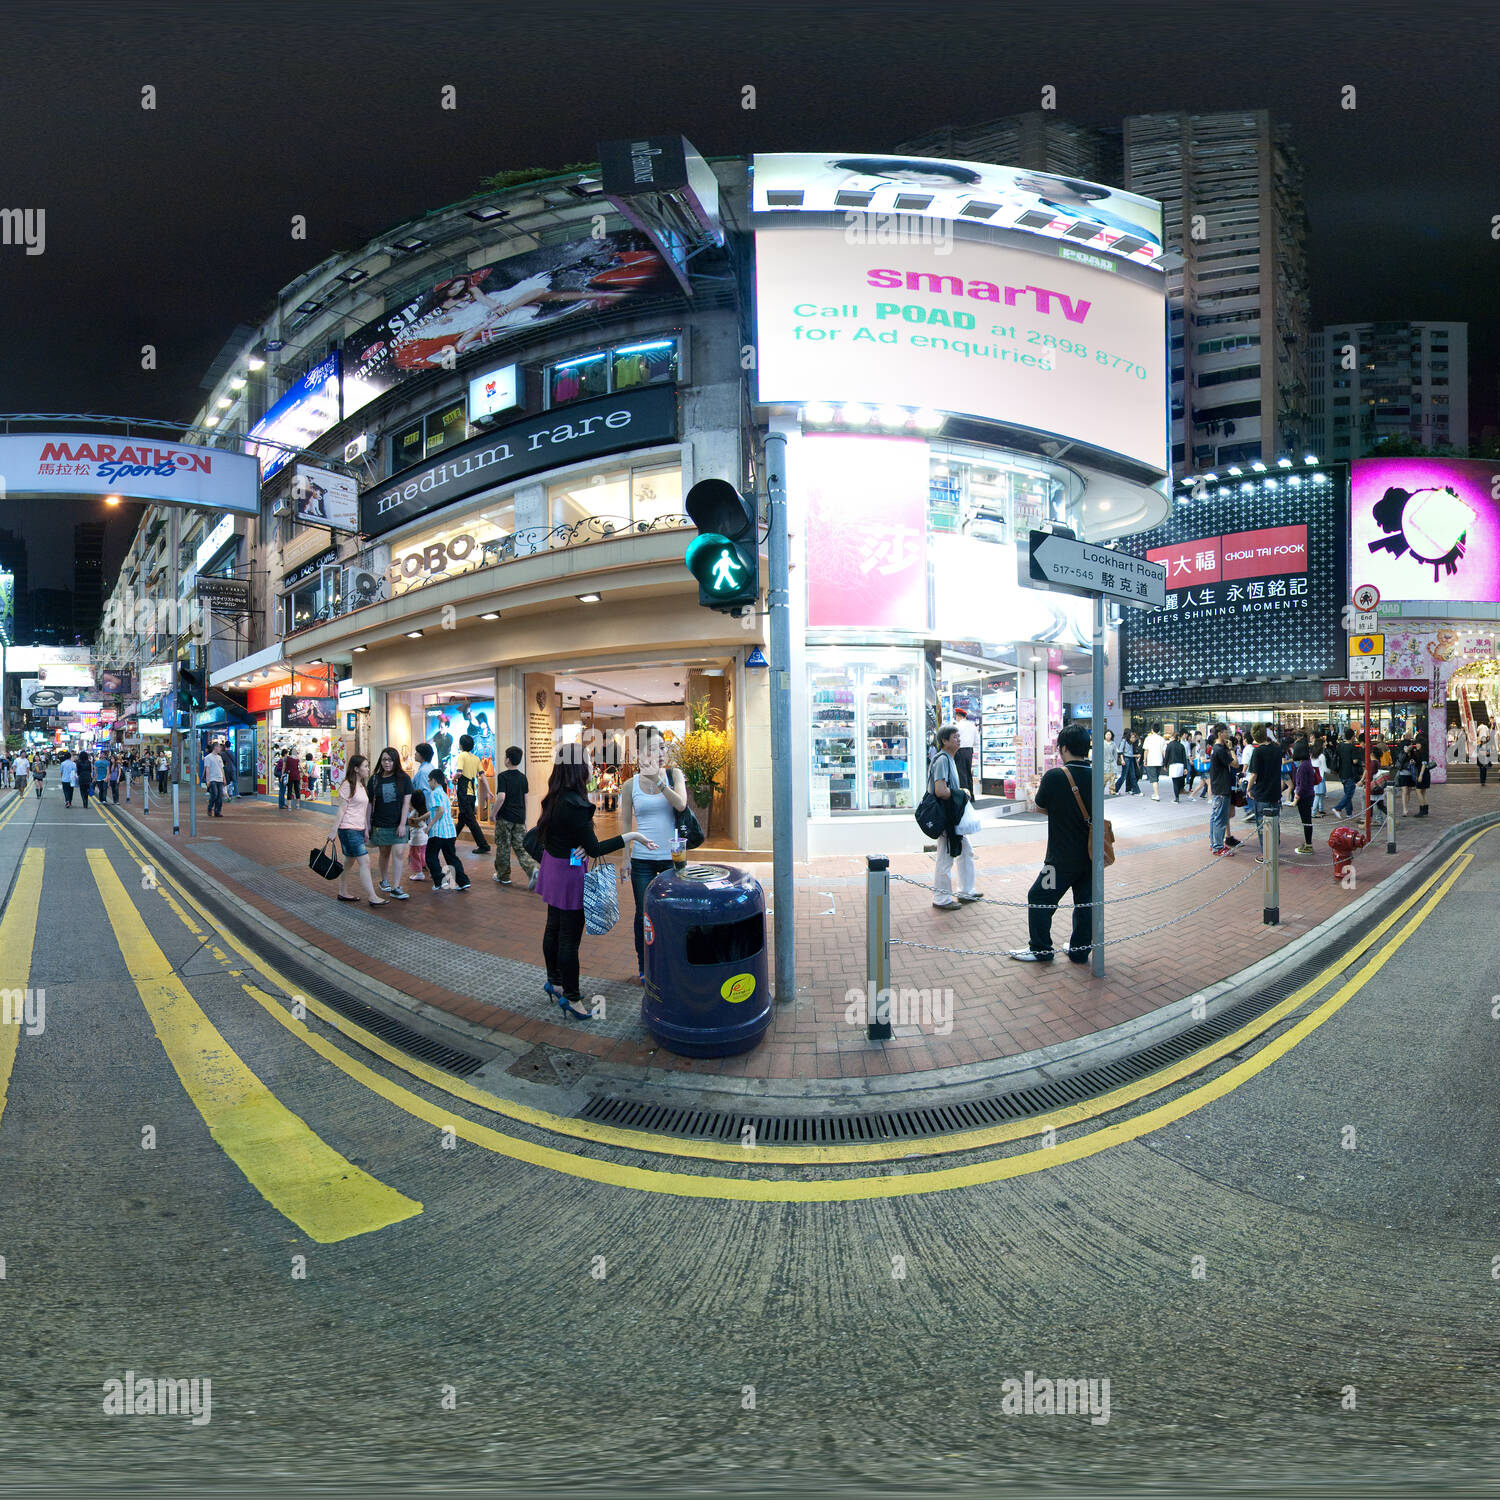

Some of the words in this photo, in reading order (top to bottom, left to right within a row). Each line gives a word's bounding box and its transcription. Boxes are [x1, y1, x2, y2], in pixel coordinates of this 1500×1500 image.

[1061, 249, 1113, 270] POAD
[866, 267, 1092, 325] smarTV
[354, 348, 389, 381] GRAND
[389, 306, 443, 348] OPENING
[793, 303, 858, 319] Call
[876, 302, 975, 330] POAD
[991, 323, 1016, 339] at
[1027, 330, 1088, 359] 2898
[1096, 350, 1148, 381] 8770
[793, 326, 841, 342] for
[853, 327, 897, 345] Ad
[911, 334, 1053, 372] enquiries
[38, 463, 90, 475] 馬拉松
[40, 443, 211, 474] MARATHON
[377, 443, 514, 515] medium
[528, 409, 631, 451] rare
[97, 461, 176, 484] Sports
[385, 535, 475, 583] COBO
[1224, 551, 1254, 561] CHOW
[1256, 548, 1272, 557] TAI
[1273, 543, 1305, 554] FOOK
[1083, 549, 1134, 573] Lockhart
[1136, 564, 1164, 581] Road
[1101, 572, 1149, 597] 駱克道
[1185, 606, 1236, 620] SHINING
[1243, 599, 1308, 613] MOMENTS
[1370, 657, 1376, 666] 7
[1463, 647, 1492, 655] Laforet
[1371, 671, 1381, 680] 12
